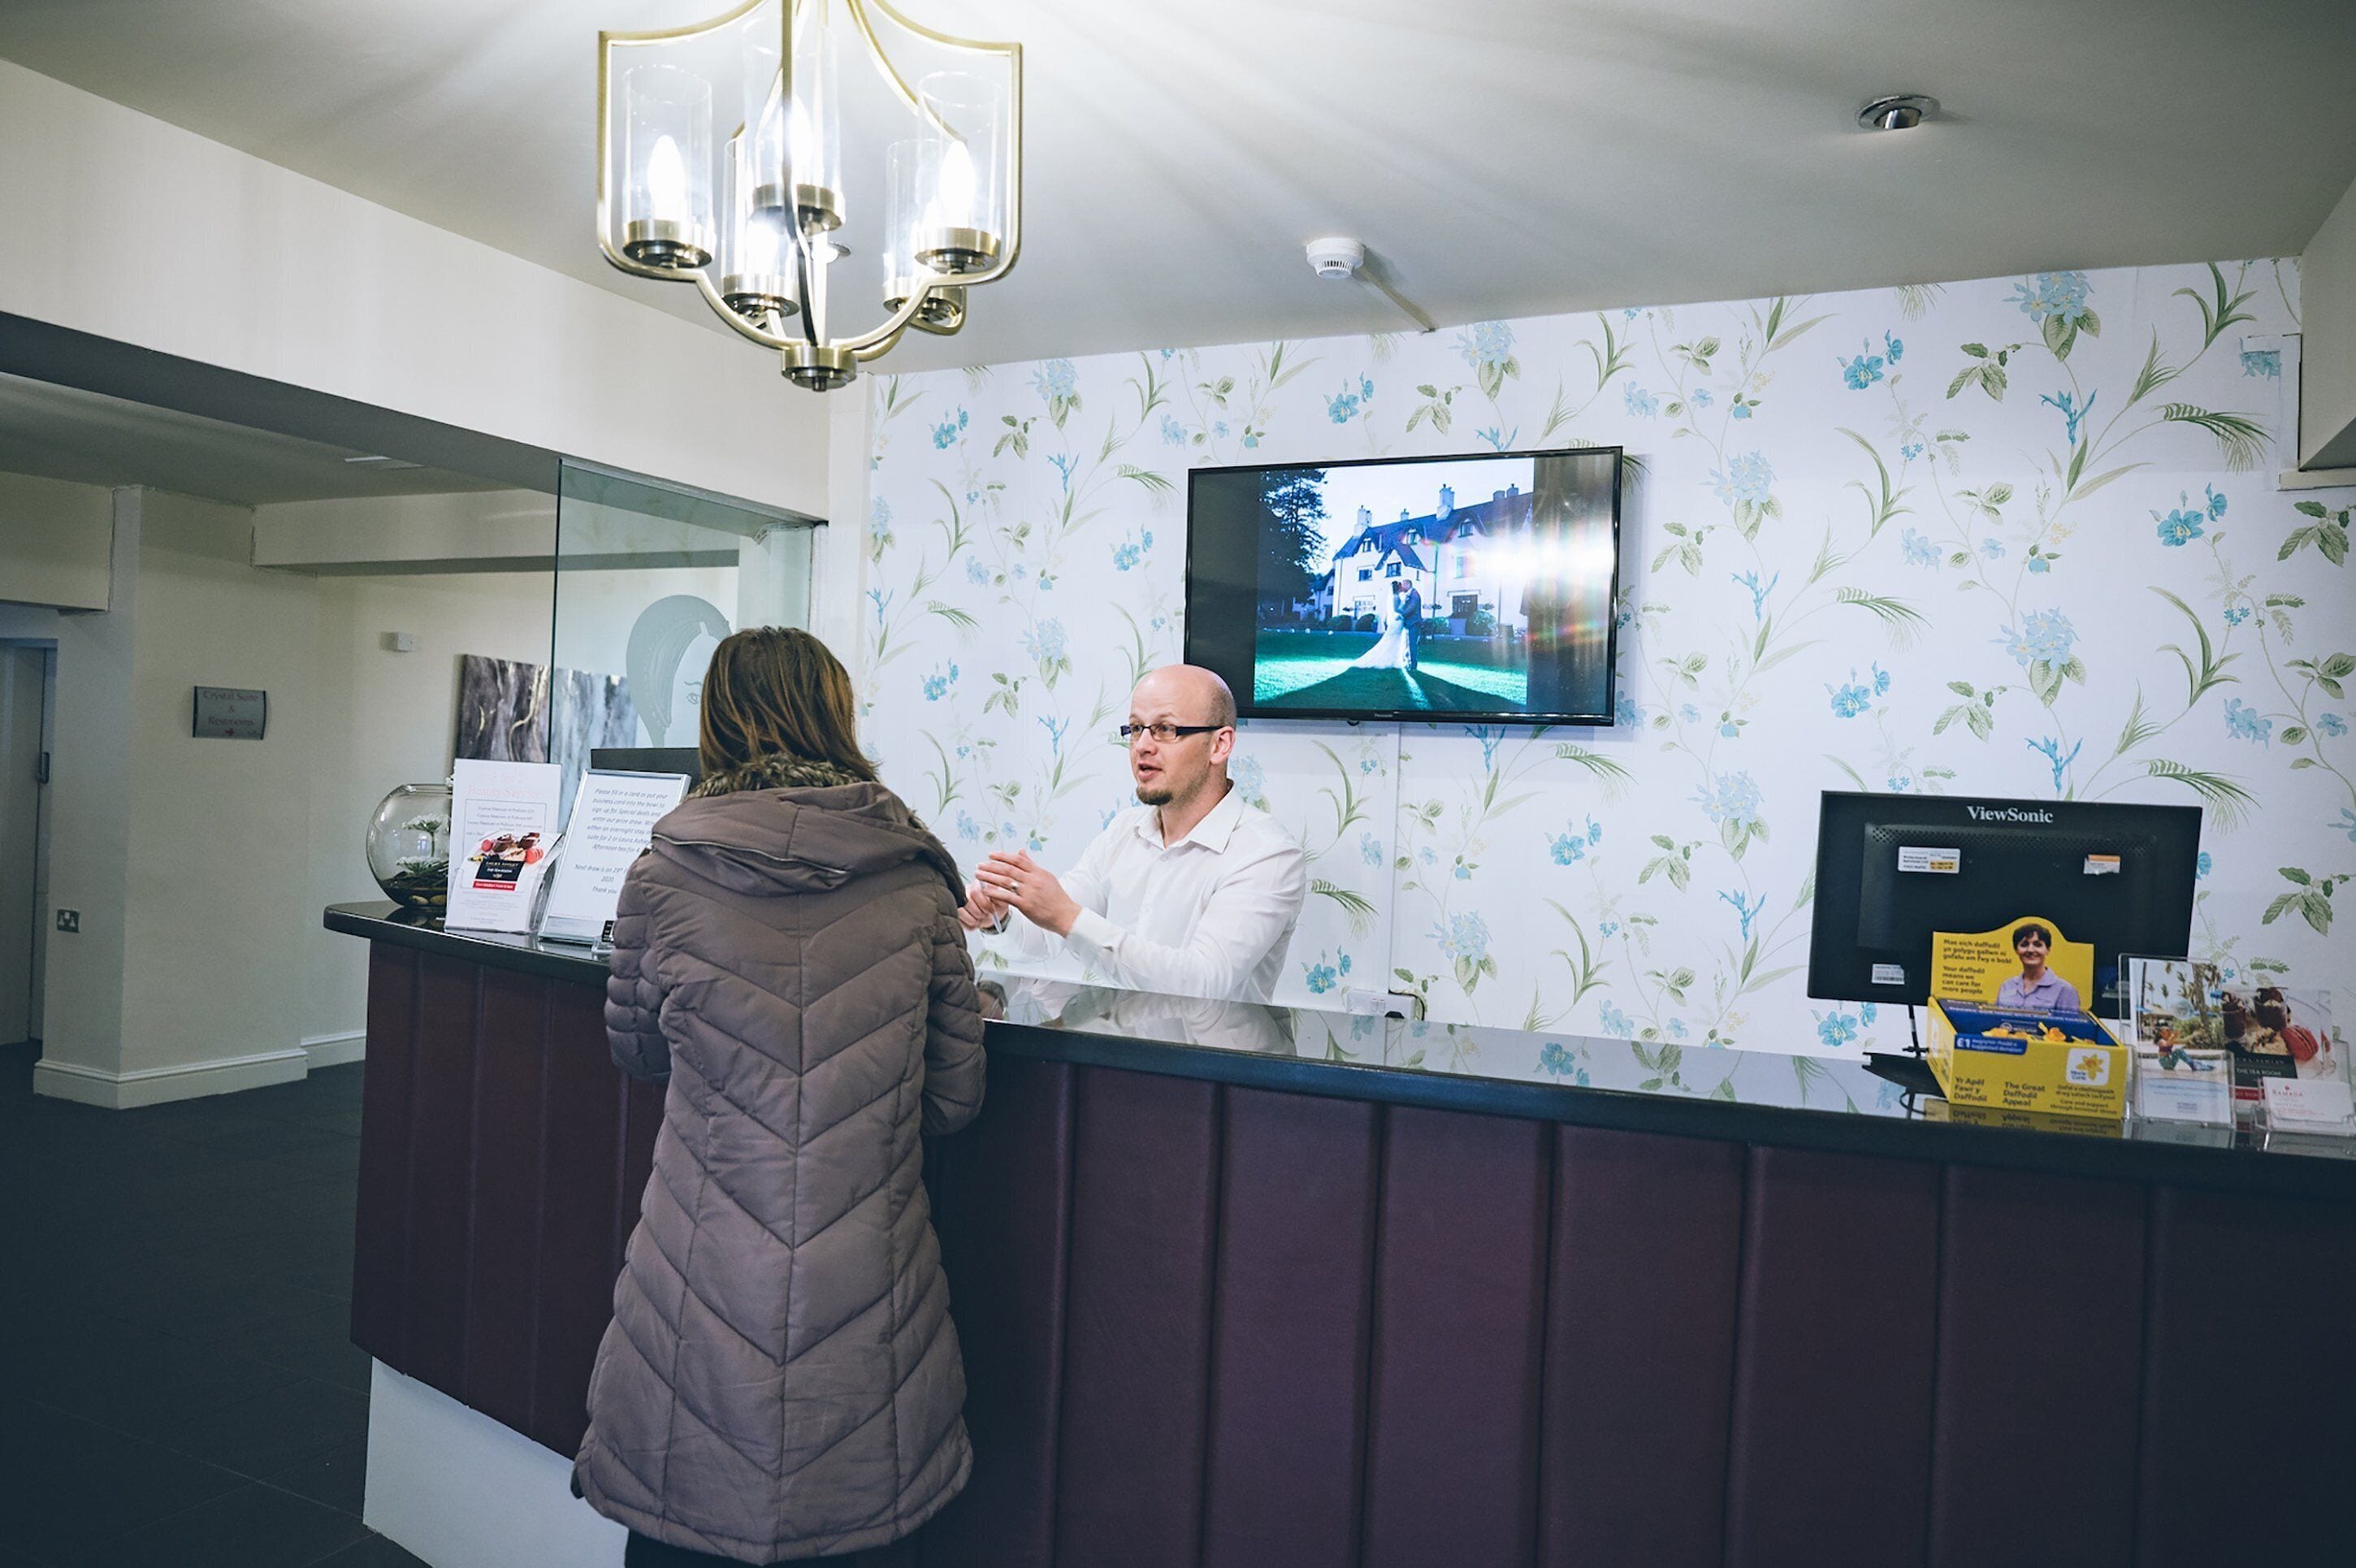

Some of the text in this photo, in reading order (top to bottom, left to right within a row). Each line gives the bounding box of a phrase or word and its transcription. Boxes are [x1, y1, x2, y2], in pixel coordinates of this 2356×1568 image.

[203, 690, 258, 701] Crystal Suite
[228, 705, 235, 713] &
[1966, 805, 2055, 824] ViewSonic
[1956, 1037, 1971, 1048] £1
[2021, 1082, 2045, 1091] Great
[1954, 1093, 1987, 1102] Daffodil
[2003, 1089, 2038, 1098] Daffodil
[2272, 1089, 2304, 1098] RAMADA
[2002, 1097, 2031, 1106] Appeal
